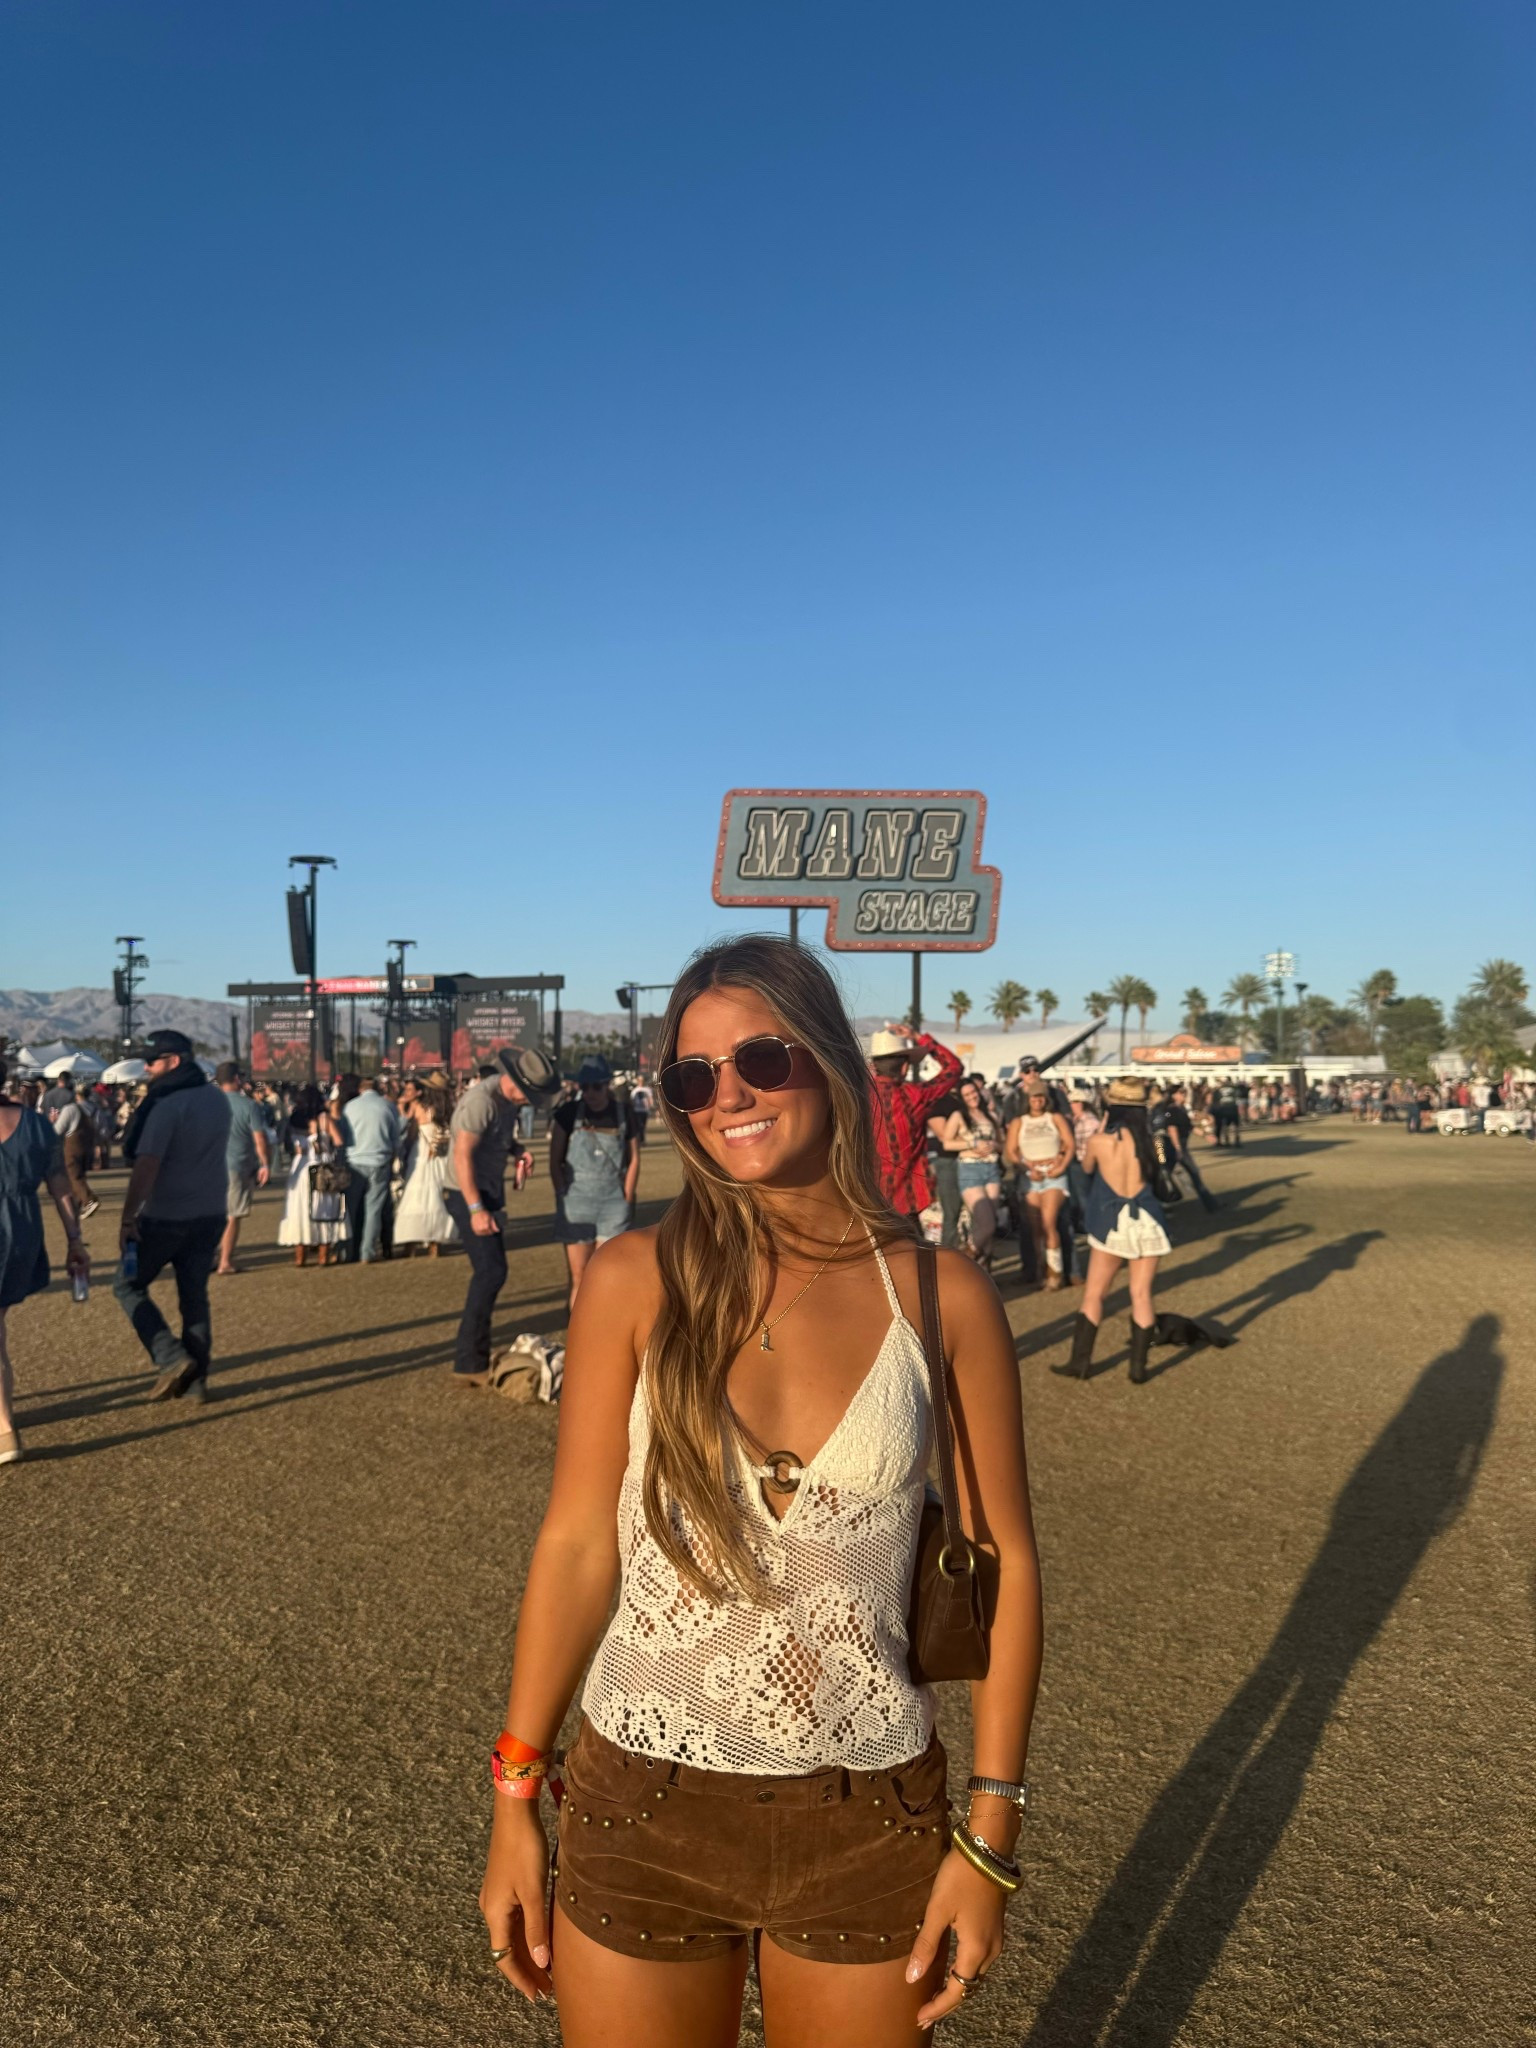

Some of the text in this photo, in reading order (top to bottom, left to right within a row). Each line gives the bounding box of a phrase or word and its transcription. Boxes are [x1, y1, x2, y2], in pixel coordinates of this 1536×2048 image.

[738, 808, 966, 881] MANE
[856, 890, 980, 933] STAGE
[466, 1016, 499, 1028] WHISKEY
